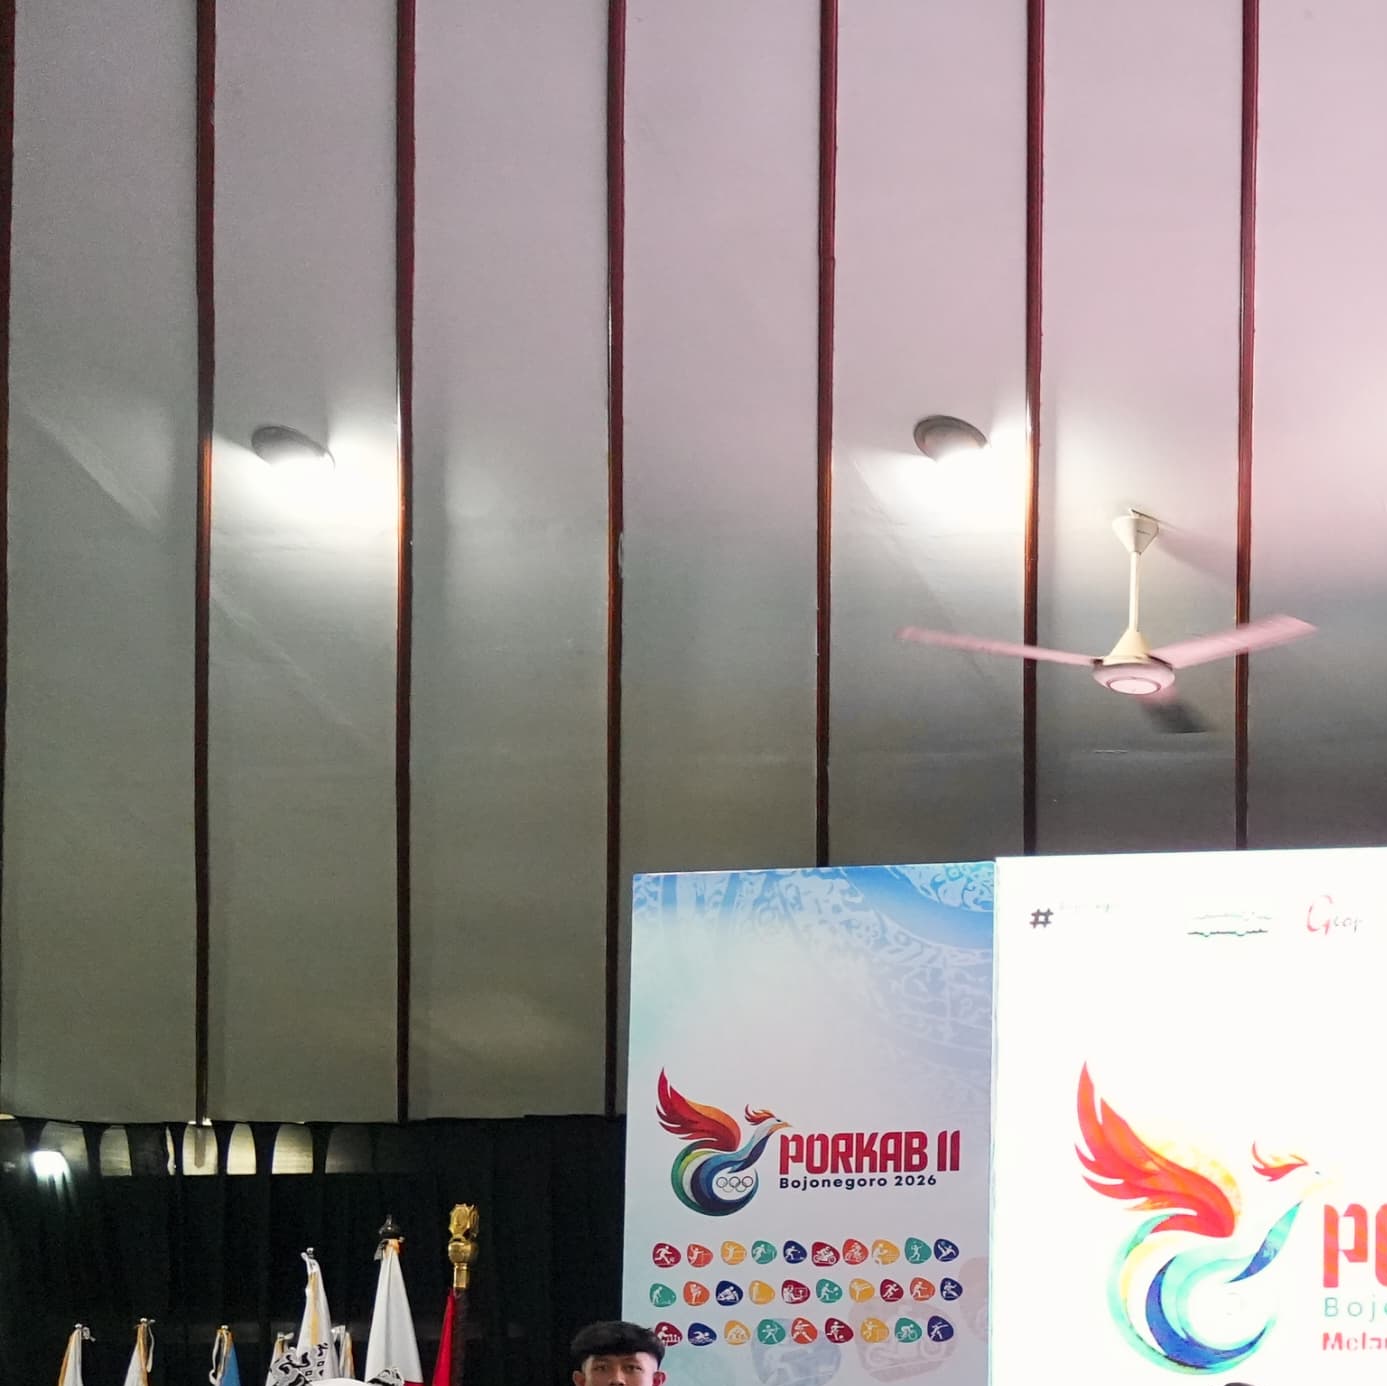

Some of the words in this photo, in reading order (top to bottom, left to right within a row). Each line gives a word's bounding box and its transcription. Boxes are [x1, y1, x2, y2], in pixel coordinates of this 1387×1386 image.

[779, 1132, 928, 1175] PORKAB
[937, 1130, 960, 1171] II
[780, 1176, 887, 1191] Bojonegoro
[895, 1175, 936, 1186] 2026
